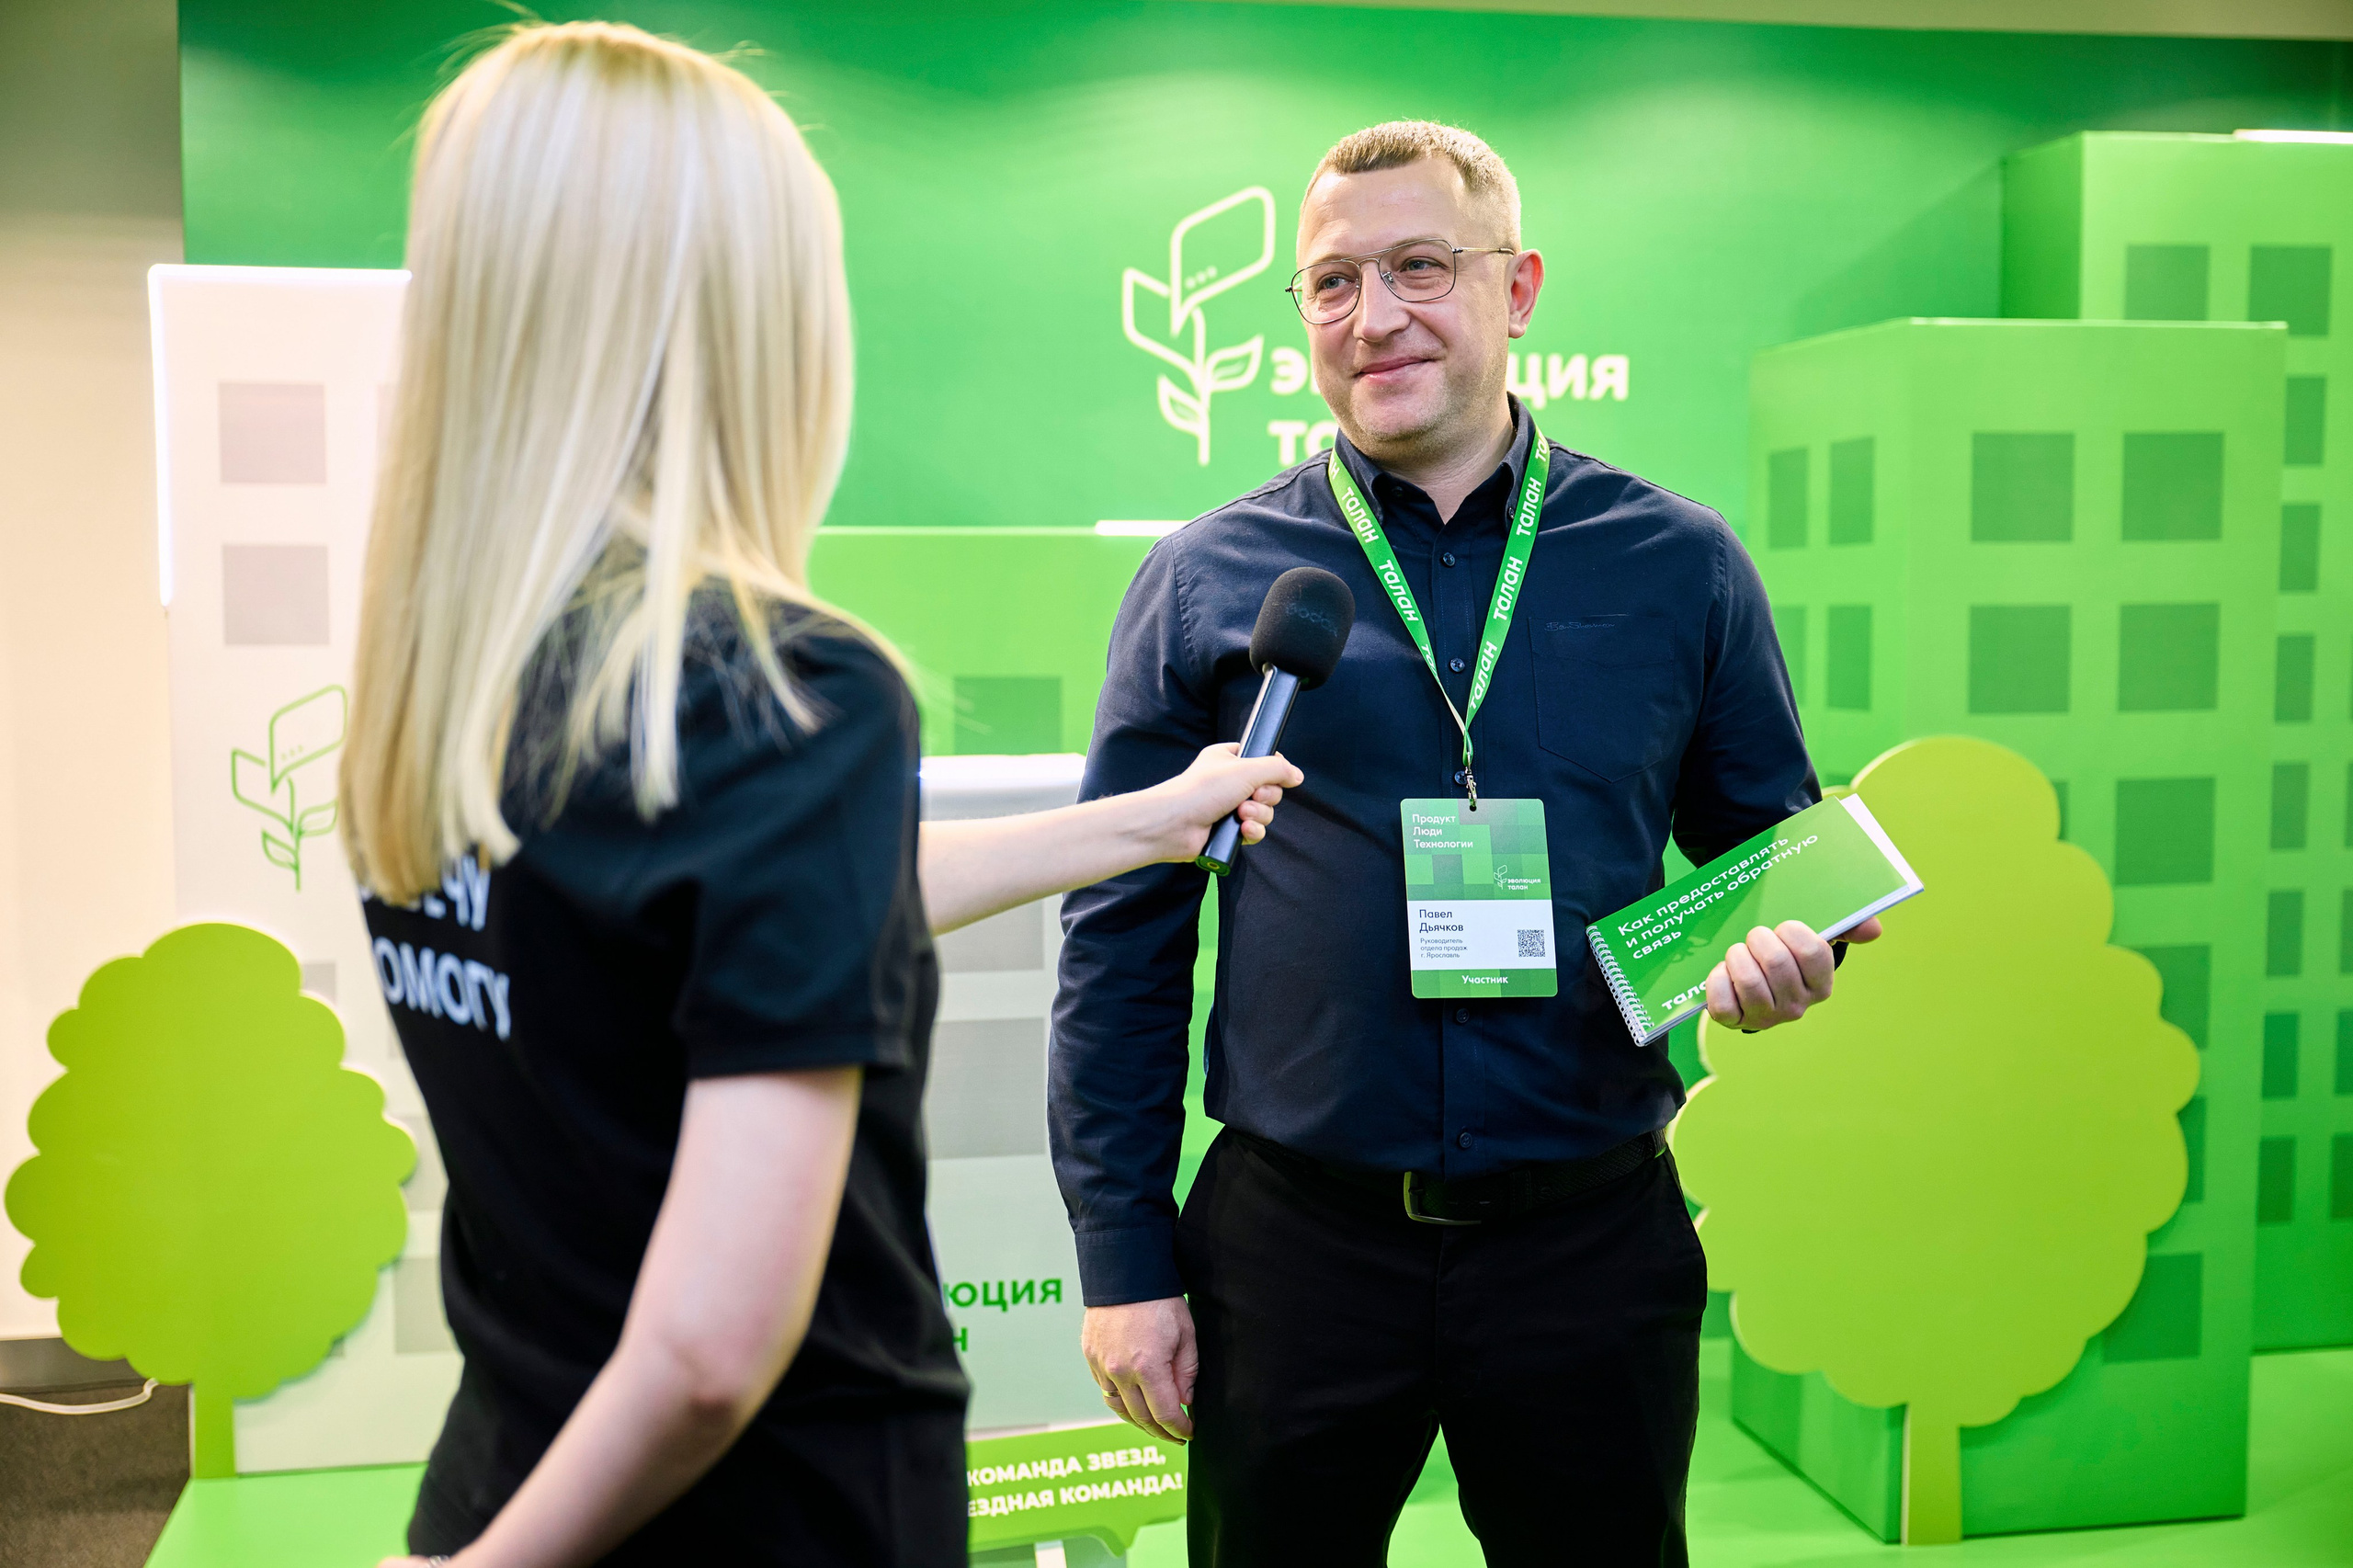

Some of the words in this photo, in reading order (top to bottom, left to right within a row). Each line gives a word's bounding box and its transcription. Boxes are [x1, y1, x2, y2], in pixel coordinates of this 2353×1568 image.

[1341, 486, 1379, 544] талан
[1516, 476, 1542, 536] талан
[1379, 559, 1419, 621] талан
[1493, 555, 1523, 621] талан
[1470, 641, 1498, 710] талан
[1412, 814, 1456, 825] Продукт
[1413, 826, 1443, 836] Люди
[1414, 839, 1473, 849] Технологии
[1618, 914, 1654, 936] Как
[1656, 837, 1789, 915] предоставлять
[1626, 937, 1638, 949] и
[1641, 890, 1724, 939] получать
[1727, 835, 1818, 892] обратную
[1419, 909, 1453, 919] Павел
[1419, 923, 1464, 934] Дьячков
[1632, 929, 1682, 960] связь
[373, 936, 511, 1041] ОМОГУ
[1461, 975, 1508, 984] Участник
[966, 1456, 1084, 1487] КОМАНДА
[1086, 1445, 1167, 1471] ЗВЕЗД,
[967, 1489, 1055, 1517] ЕЗДНАЯ
[1059, 1471, 1184, 1506] КОМАНДА!
